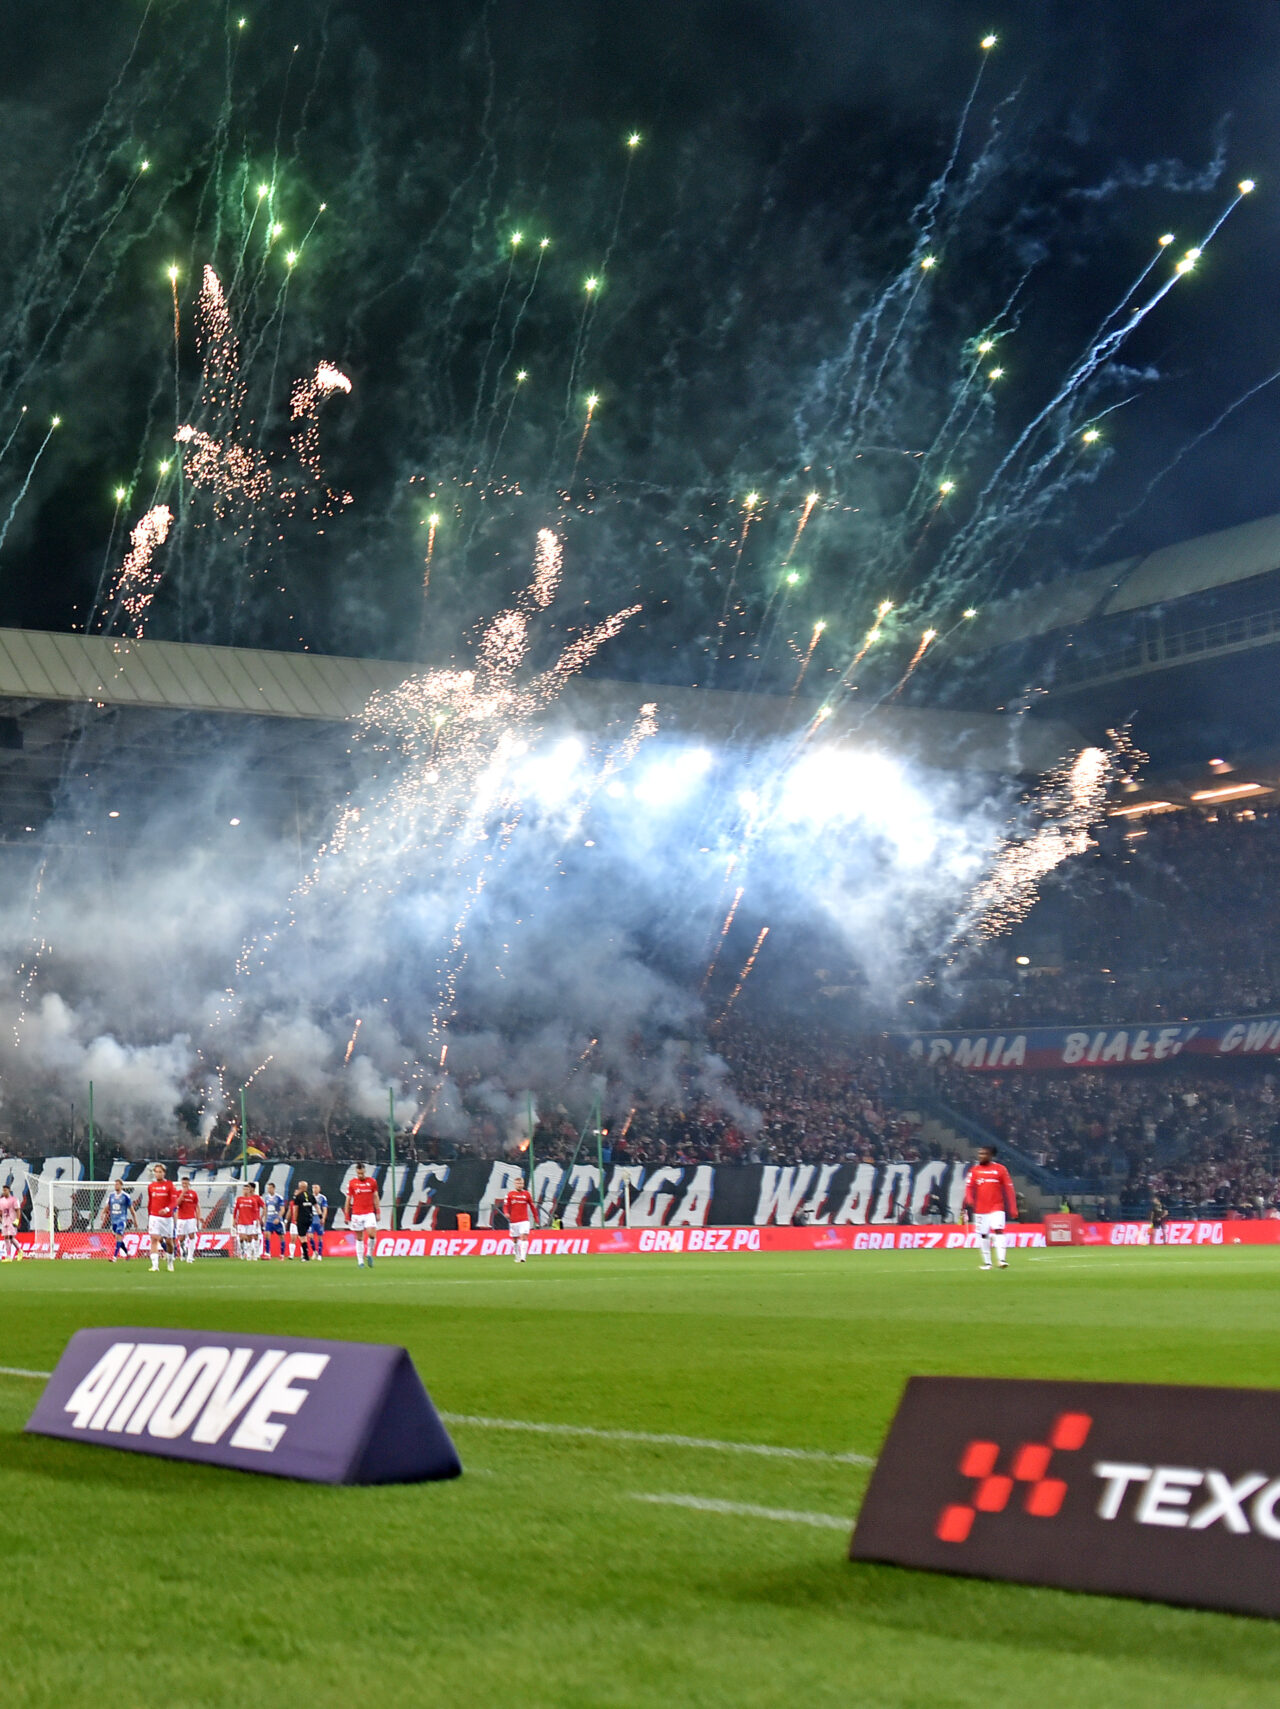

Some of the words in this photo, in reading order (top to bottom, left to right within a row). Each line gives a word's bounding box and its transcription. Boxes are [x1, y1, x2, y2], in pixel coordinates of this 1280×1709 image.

[638, 1229, 684, 1252] GRA
[687, 1229, 732, 1251] BEZ
[853, 1232, 895, 1250] GRA
[898, 1232, 943, 1249] BEZ
[1109, 1223, 1151, 1245] GRA
[376, 1238, 426, 1256] GRA
[430, 1239, 478, 1256] BEZ
[63, 1343, 331, 1453] 4MOVE
